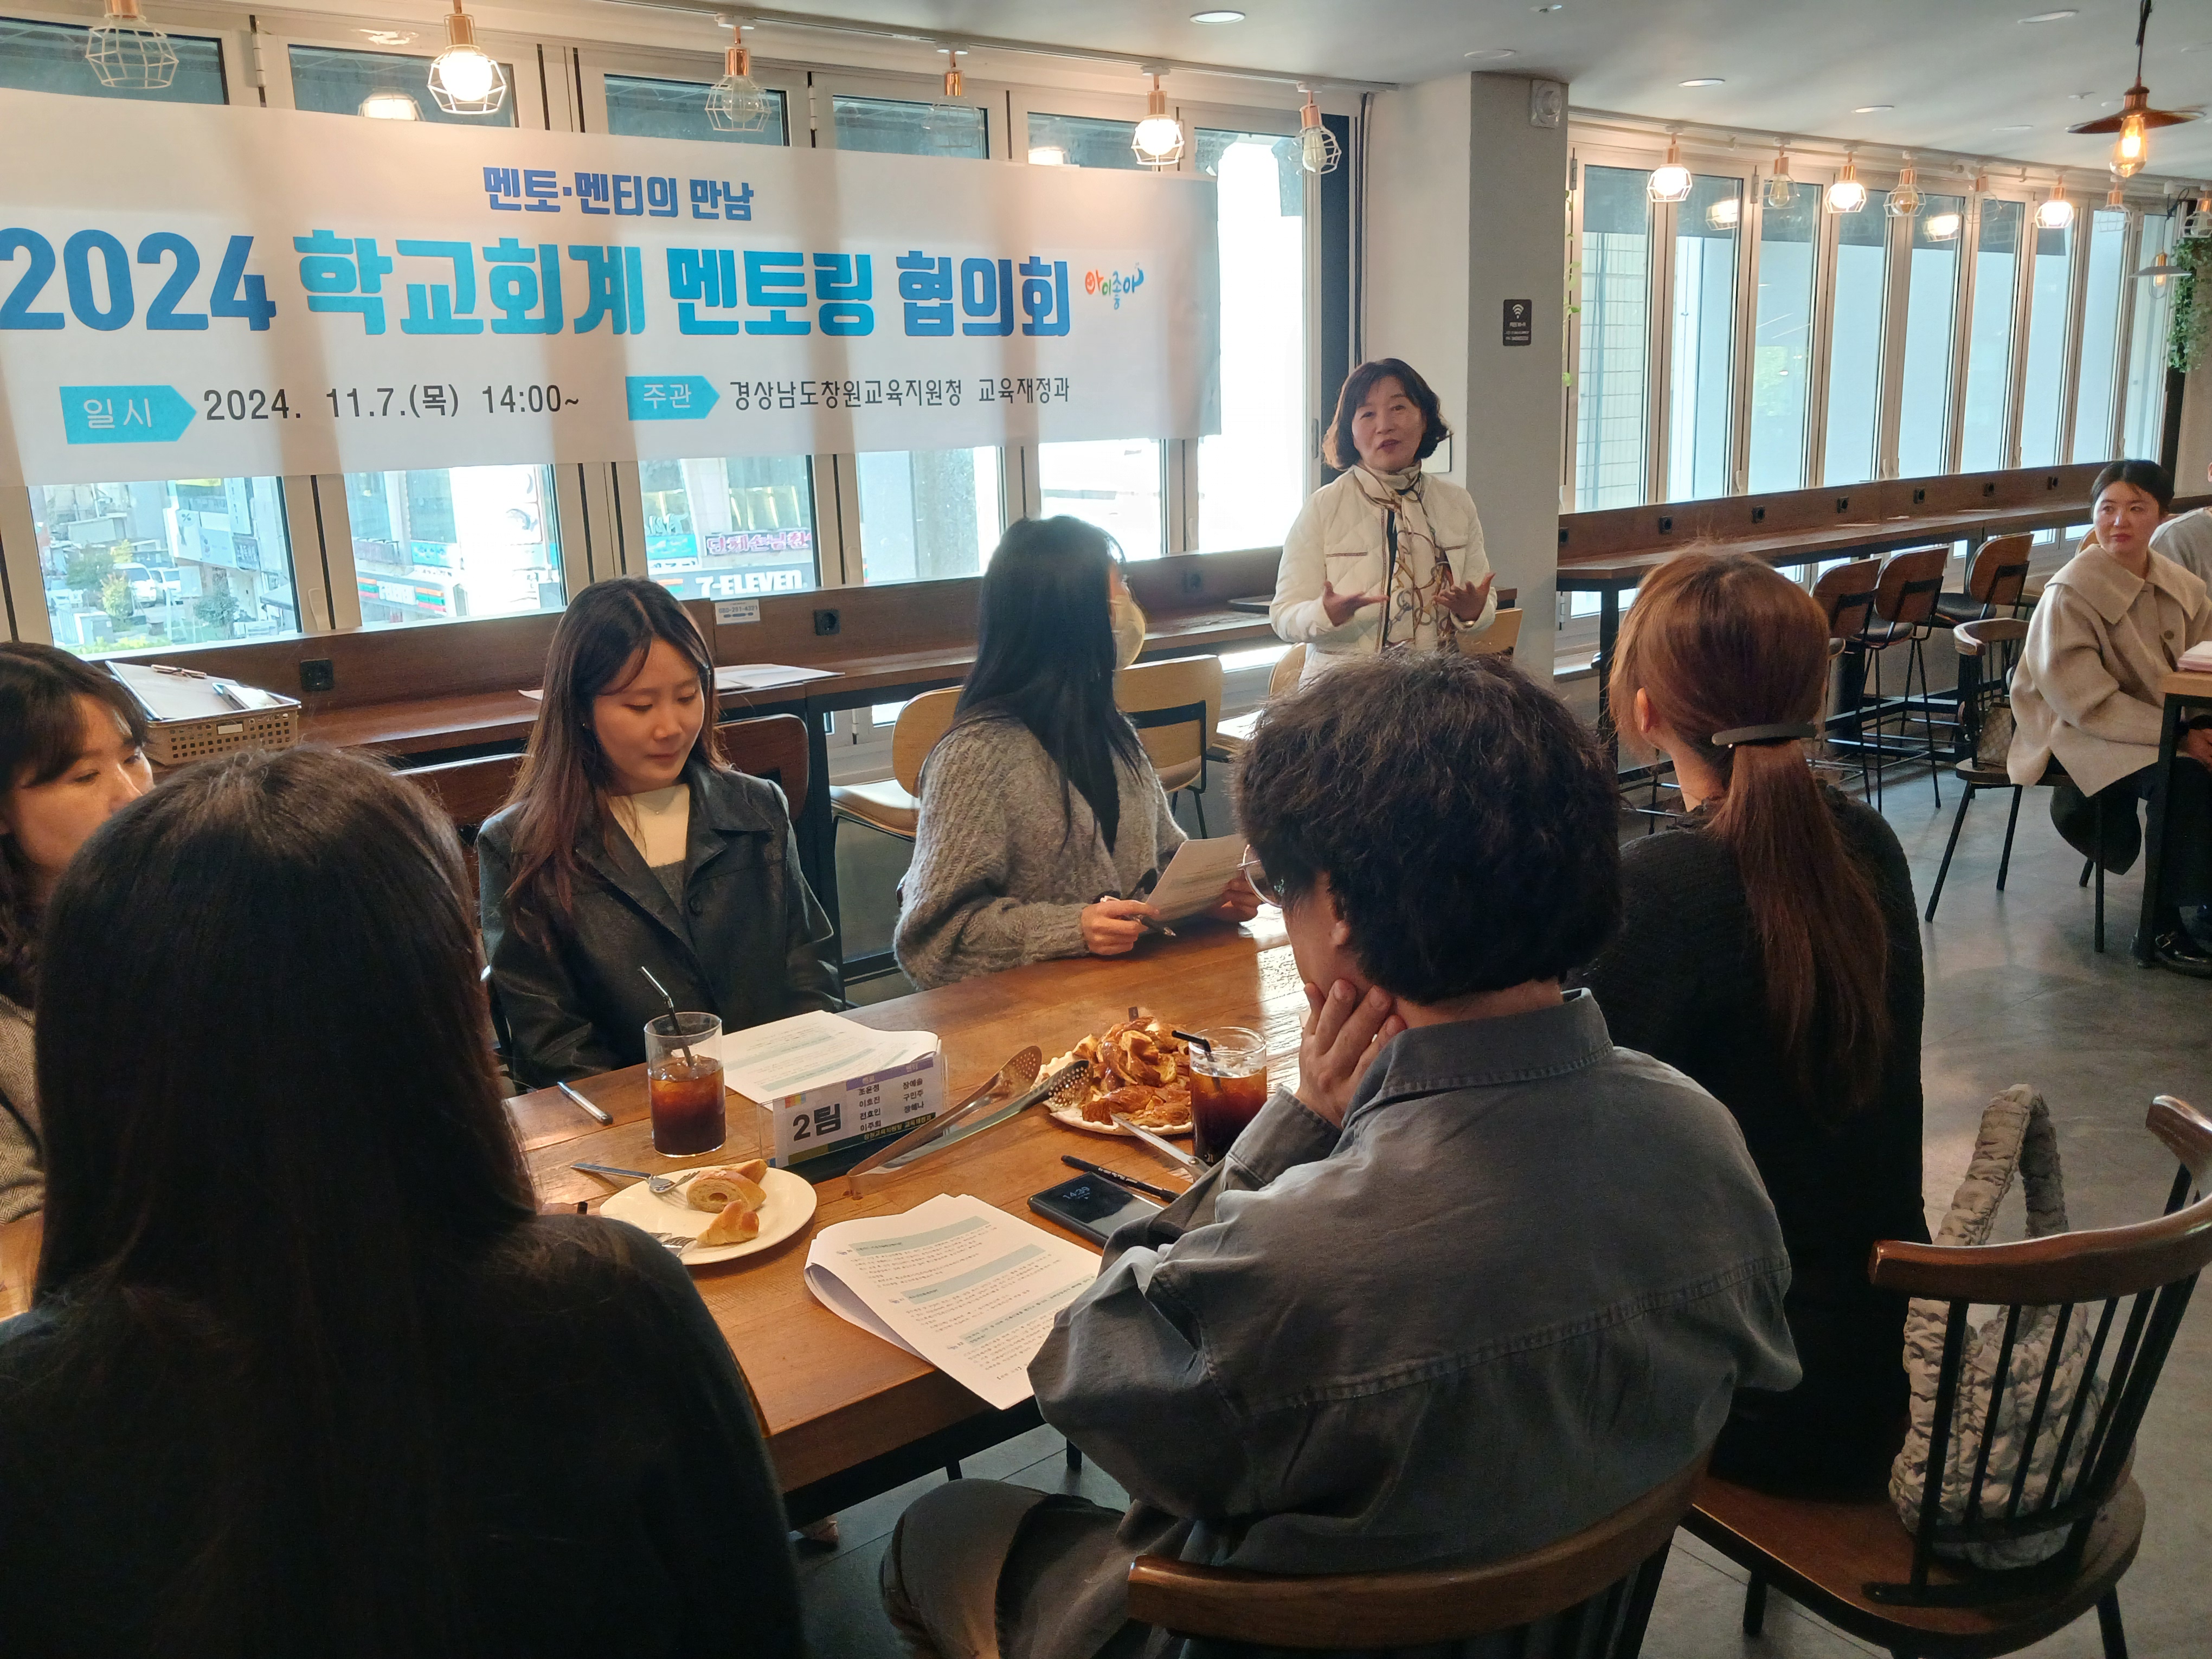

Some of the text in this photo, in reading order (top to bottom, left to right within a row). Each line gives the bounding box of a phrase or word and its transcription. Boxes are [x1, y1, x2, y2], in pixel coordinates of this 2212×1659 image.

[483, 166, 754, 221] 멘토·멘티의 만남
[0, 227, 1071, 337] 2024 학교회계 멘토링 협의회
[1085, 268, 1144, 310] 아이좋아
[204, 384, 579, 421] 2024. 11.7.(목) 14:00~
[642, 383, 692, 410] 주관
[729, 377, 1070, 411] 경상남도창원교육지원청 교육재정과
[793, 1103, 841, 1141] 2팀
